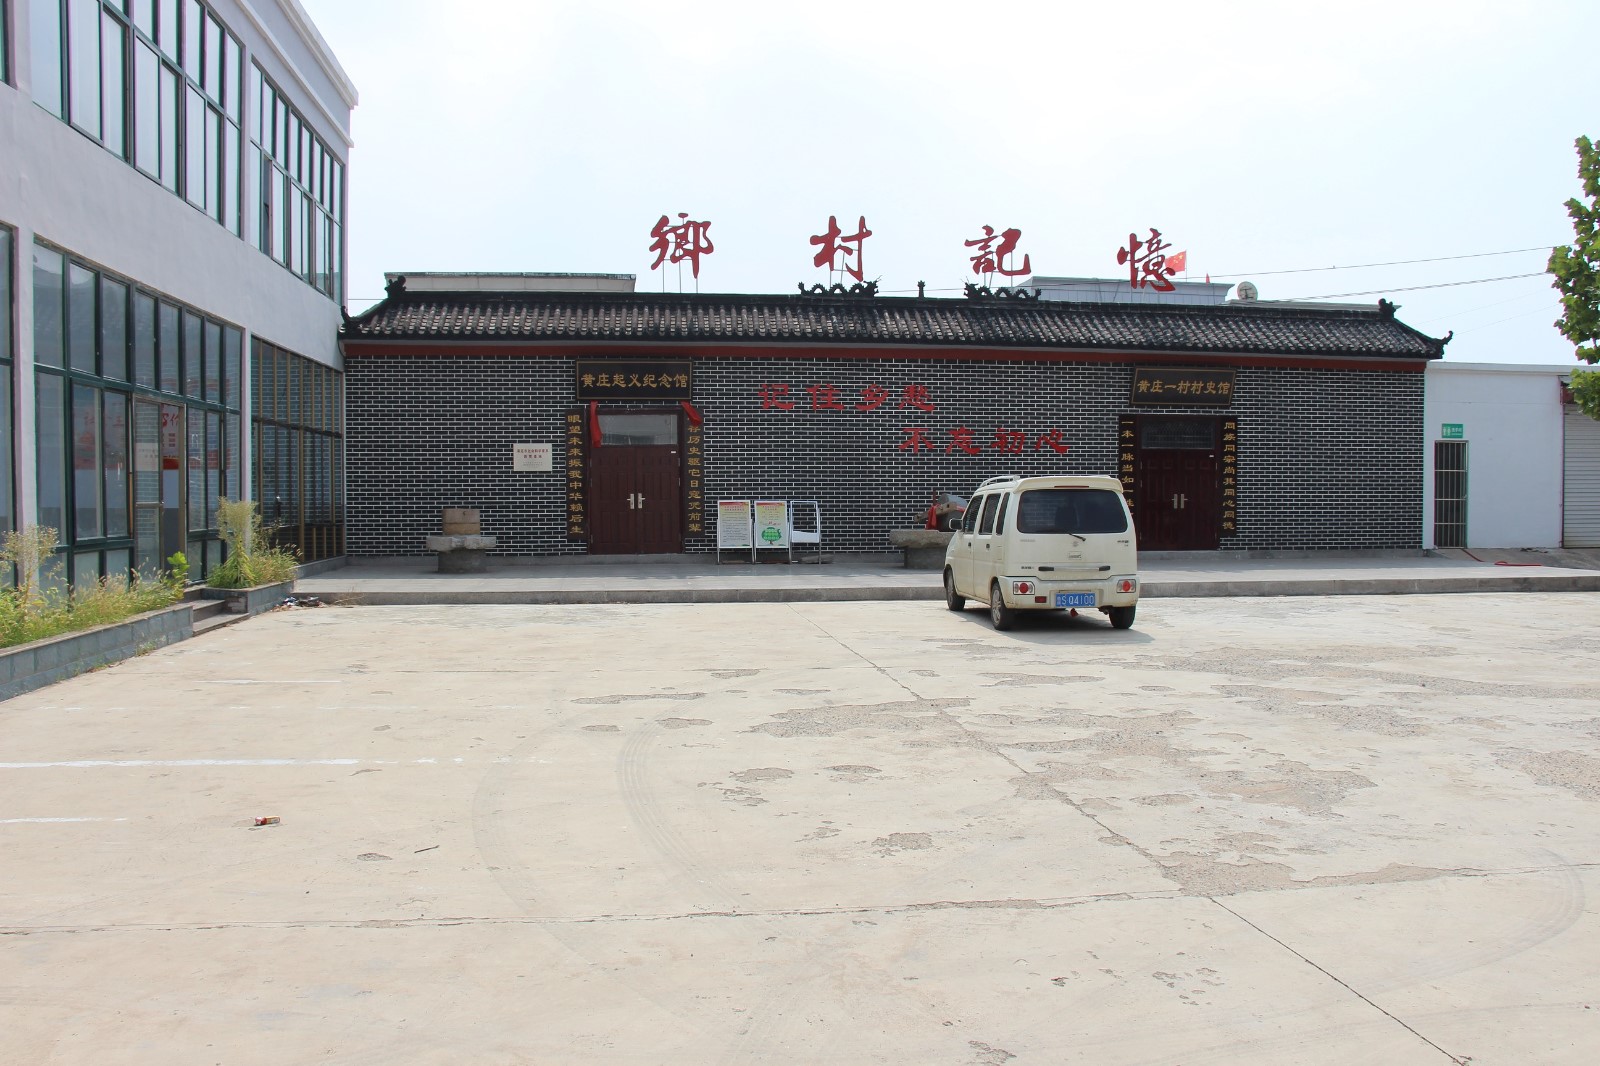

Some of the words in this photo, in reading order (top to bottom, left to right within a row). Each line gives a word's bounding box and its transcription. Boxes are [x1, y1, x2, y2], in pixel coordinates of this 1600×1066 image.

[649, 212, 1176, 293] 鄉村記憶
[581, 373, 688, 388] 黄庄起义纪念馆
[1137, 380, 1231, 395] 黄庄一村村史馆
[757, 383, 935, 412] 记住乡愁
[898, 426, 1070, 455] 不忘初心
